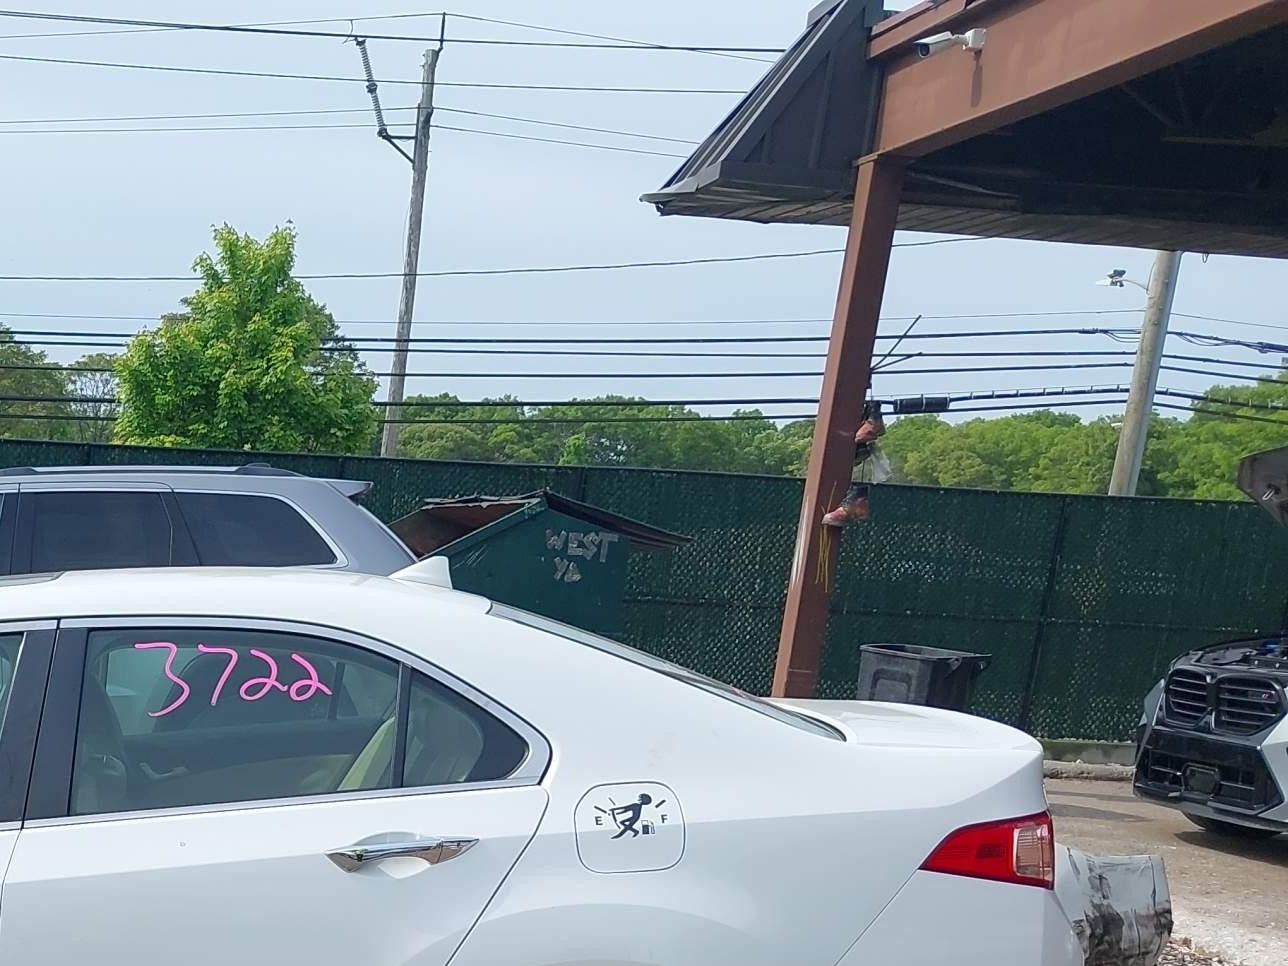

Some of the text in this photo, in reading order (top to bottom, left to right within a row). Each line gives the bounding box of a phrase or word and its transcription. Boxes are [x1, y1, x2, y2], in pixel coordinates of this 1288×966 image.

[545, 528, 618, 563] WEST
[134, 641, 333, 718] 3722
[594, 814, 668, 826] E F
